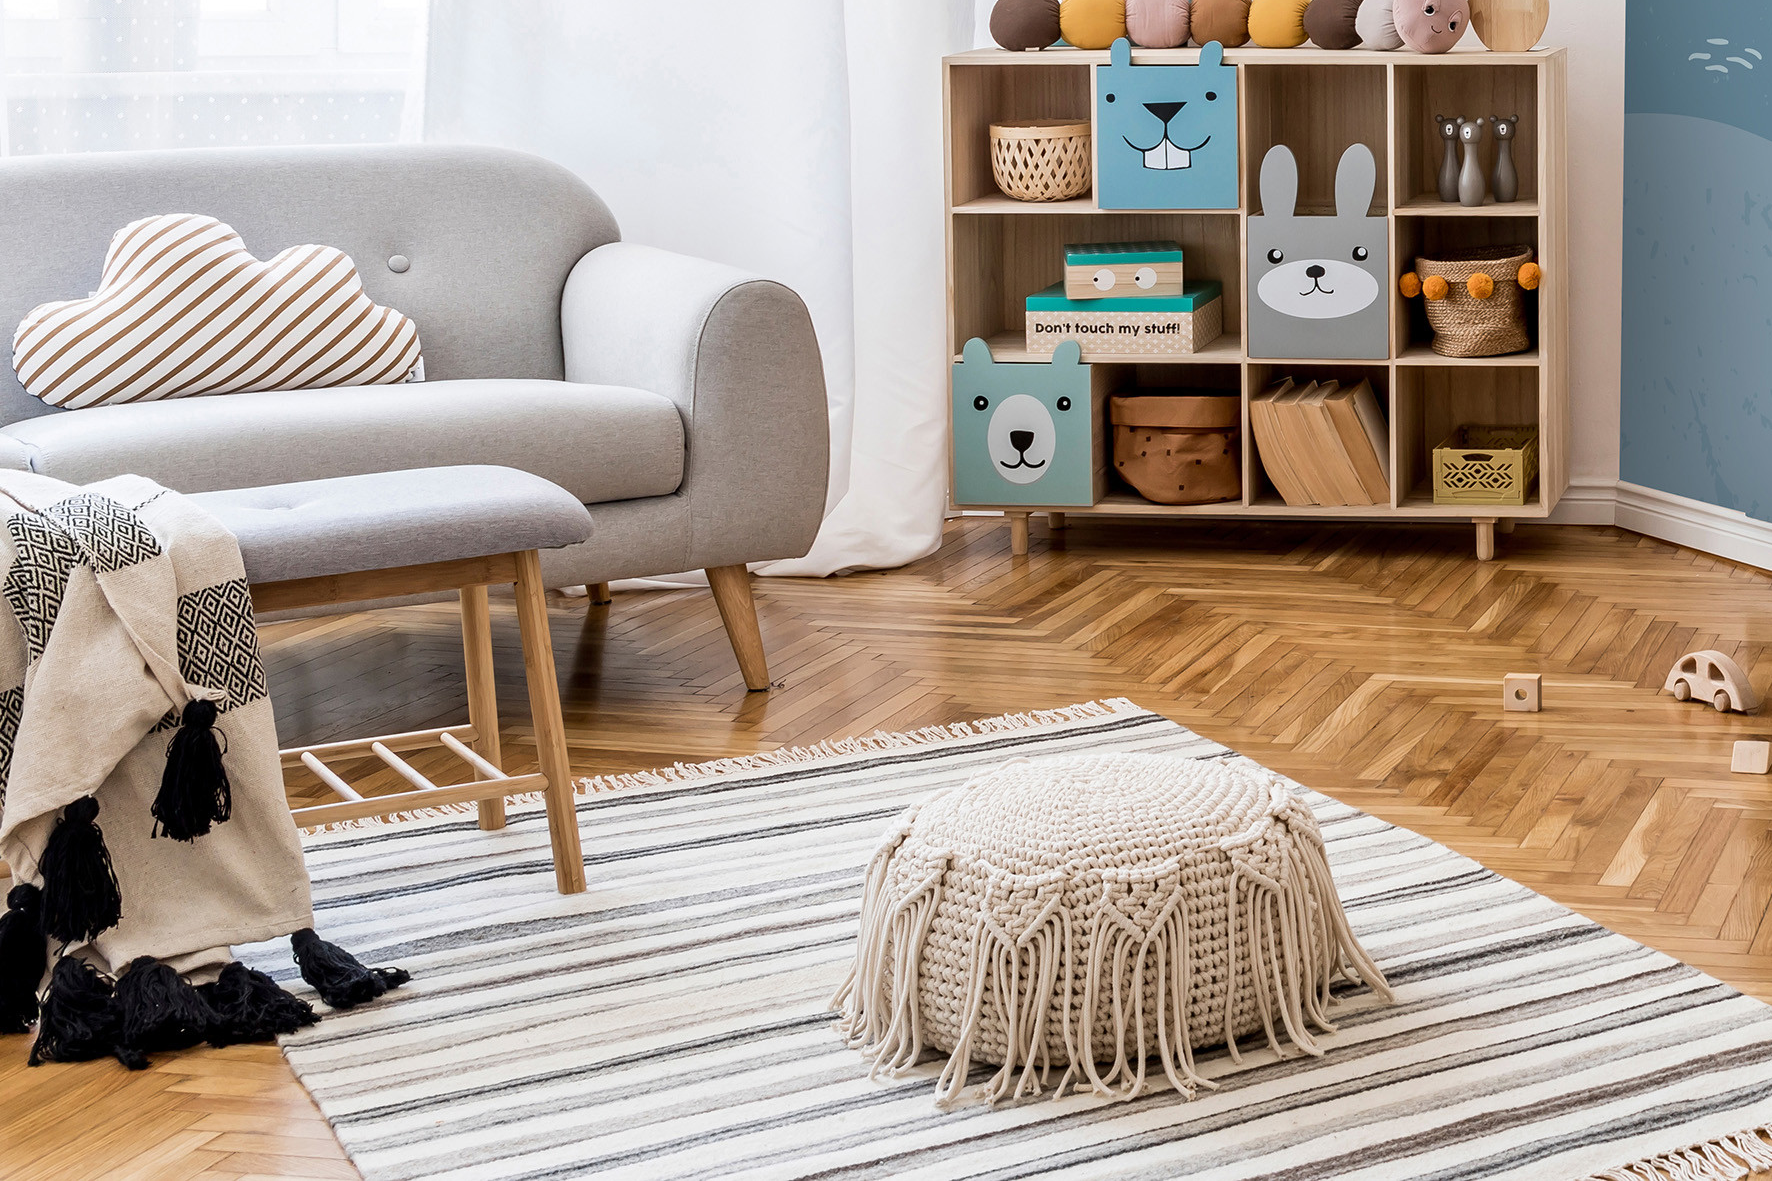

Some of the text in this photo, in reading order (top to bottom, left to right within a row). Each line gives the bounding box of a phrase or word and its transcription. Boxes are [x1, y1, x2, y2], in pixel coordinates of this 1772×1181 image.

[1034, 322, 1181, 337] Don't touch my stuff!
